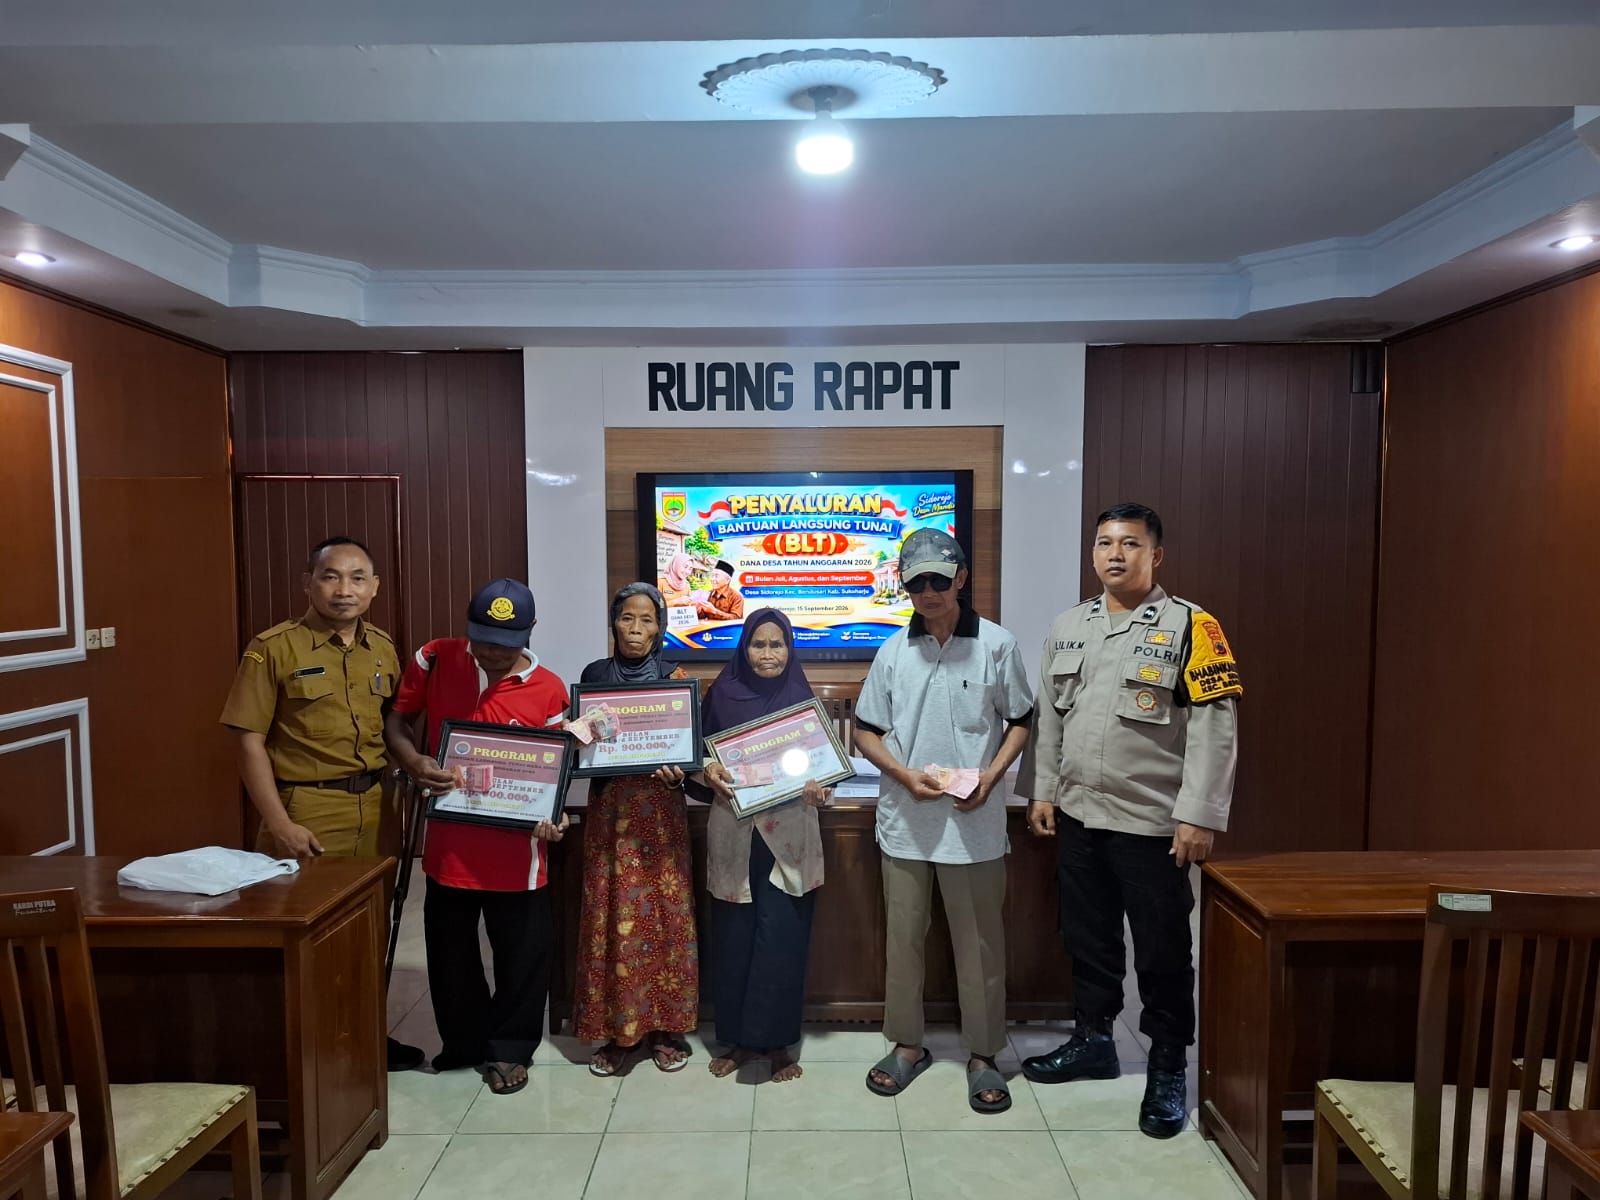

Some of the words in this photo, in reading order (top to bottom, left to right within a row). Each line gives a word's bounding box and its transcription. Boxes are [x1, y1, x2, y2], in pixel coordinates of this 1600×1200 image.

[648, 362, 794, 411] RUANG
[814, 361, 960, 411] RAPAT
[728, 494, 882, 516] PENYALURAN
[718, 520, 779, 534] BANTUAN
[782, 520, 851, 530] LANGSUNG
[855, 520, 892, 533] TUNAI
[775, 533, 836, 556] (BLT)
[830, 575, 867, 583] September
[1133, 645, 1178, 663] POLRI
[1200, 676, 1223, 687] DESA
[743, 730, 802, 755] PROGRAM
[473, 747, 537, 762] PROGRAM
